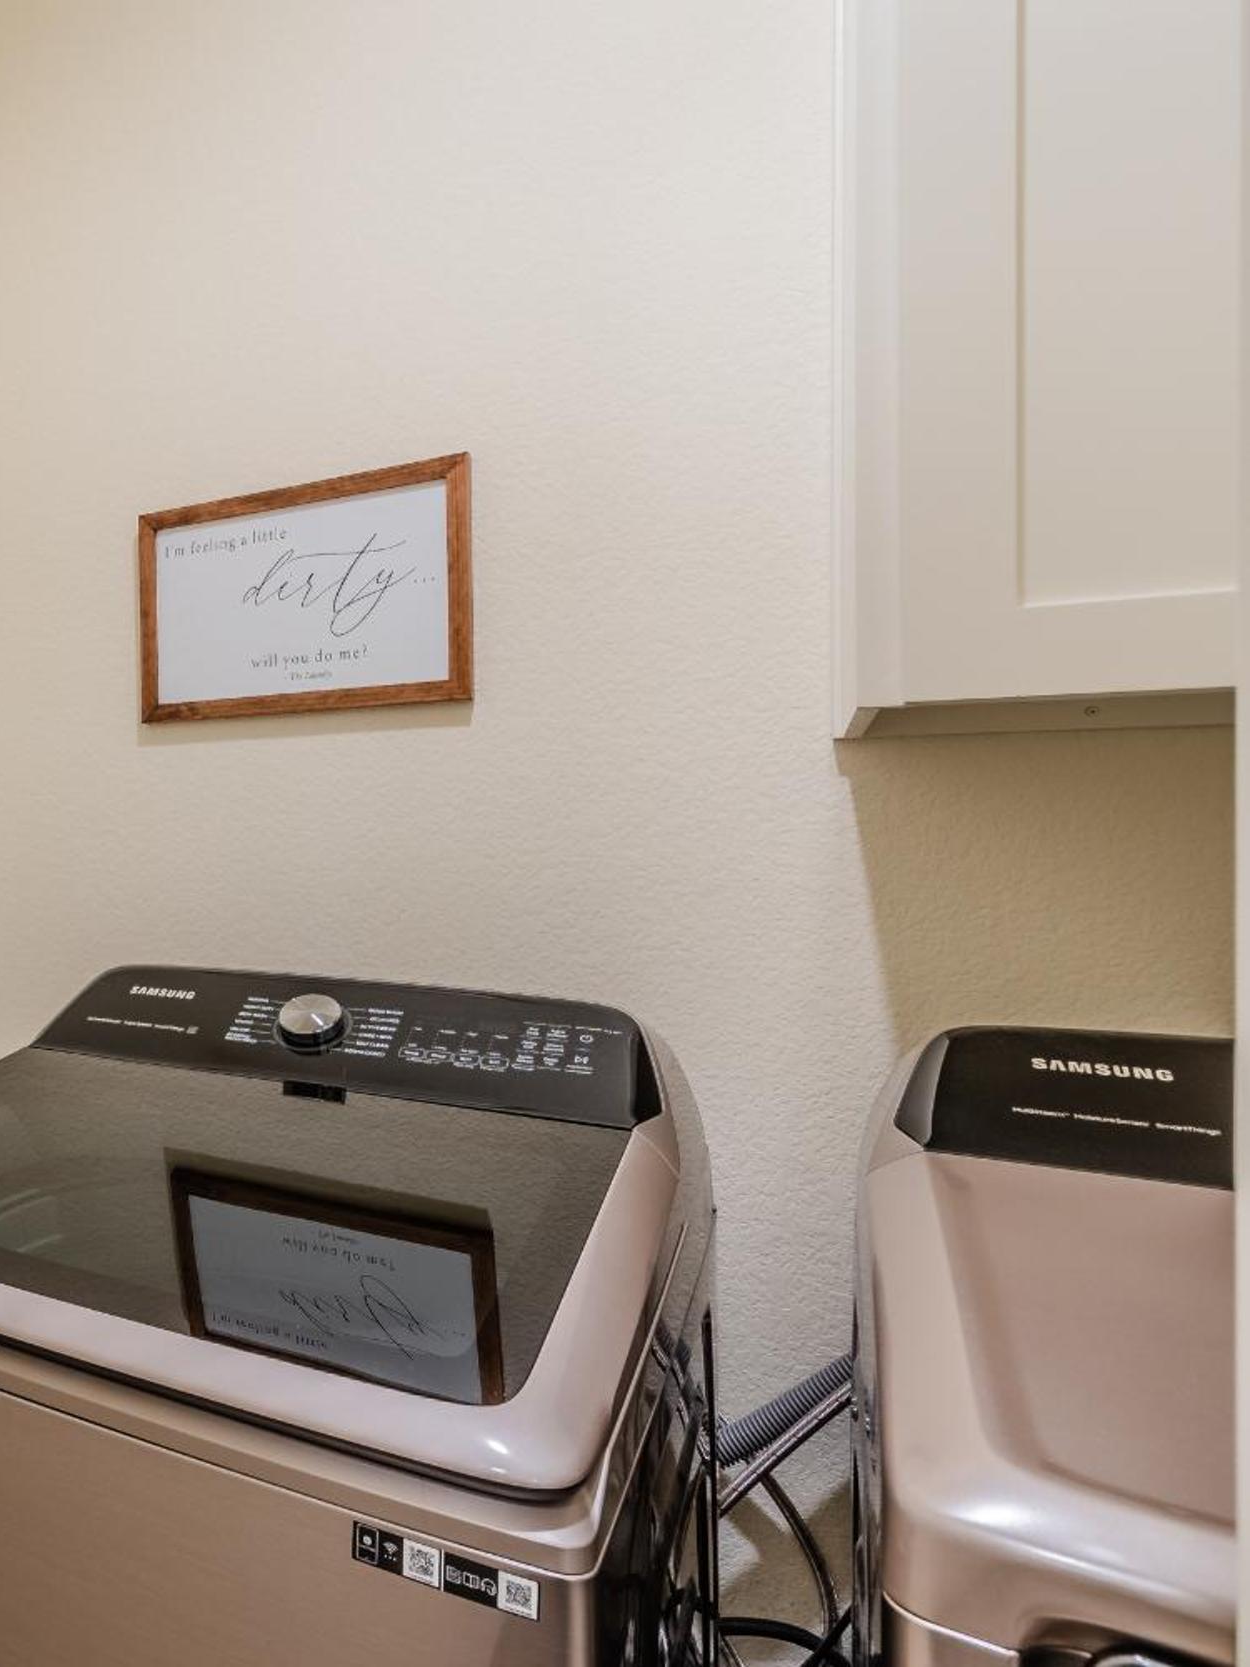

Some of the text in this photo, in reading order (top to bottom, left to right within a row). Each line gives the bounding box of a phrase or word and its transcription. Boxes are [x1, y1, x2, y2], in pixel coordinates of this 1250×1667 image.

[164, 526, 288, 559] I'm feeling a little
[250, 643, 368, 671] will you do me?
[129, 985, 196, 1000] SAMSUNG
[1030, 1057, 1174, 1082] SAMSUNG
